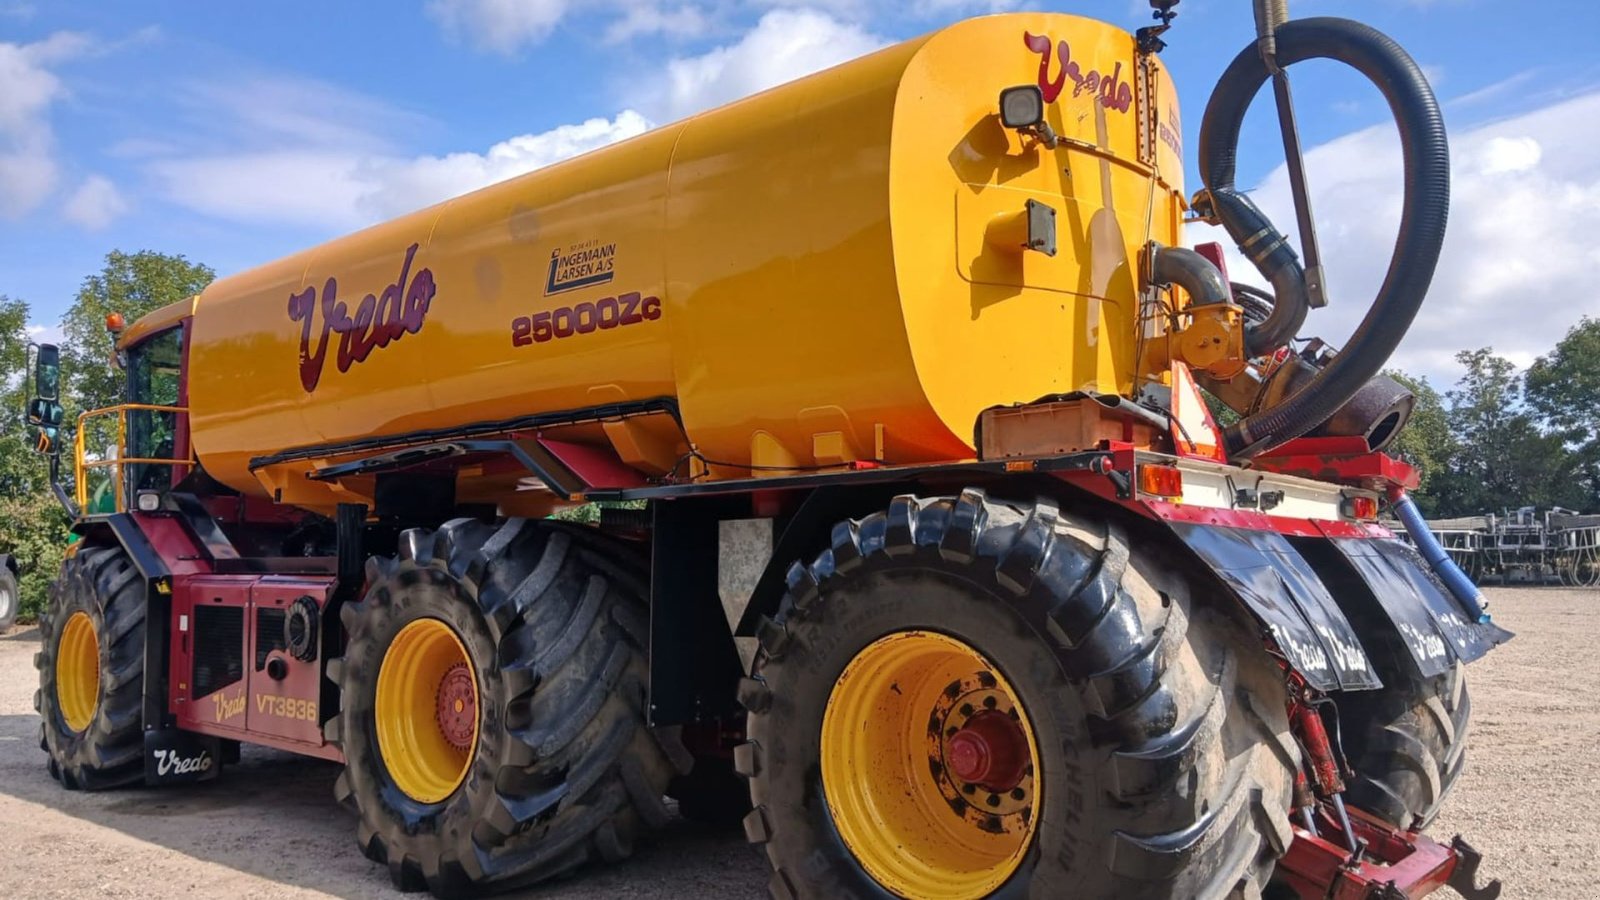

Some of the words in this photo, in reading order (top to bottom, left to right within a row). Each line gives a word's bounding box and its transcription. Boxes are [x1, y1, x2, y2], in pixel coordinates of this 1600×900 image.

[559, 243, 616, 268] INGEMANN
[557, 262, 594, 281] LARSEN
[595, 258, 613, 273] A/S
[289, 243, 437, 392] Vredo
[512, 292, 661, 346] 25000Zc
[213, 690, 245, 722] Vredo
[257, 694, 316, 721] VT3936
[154, 750, 212, 775] Vredo
